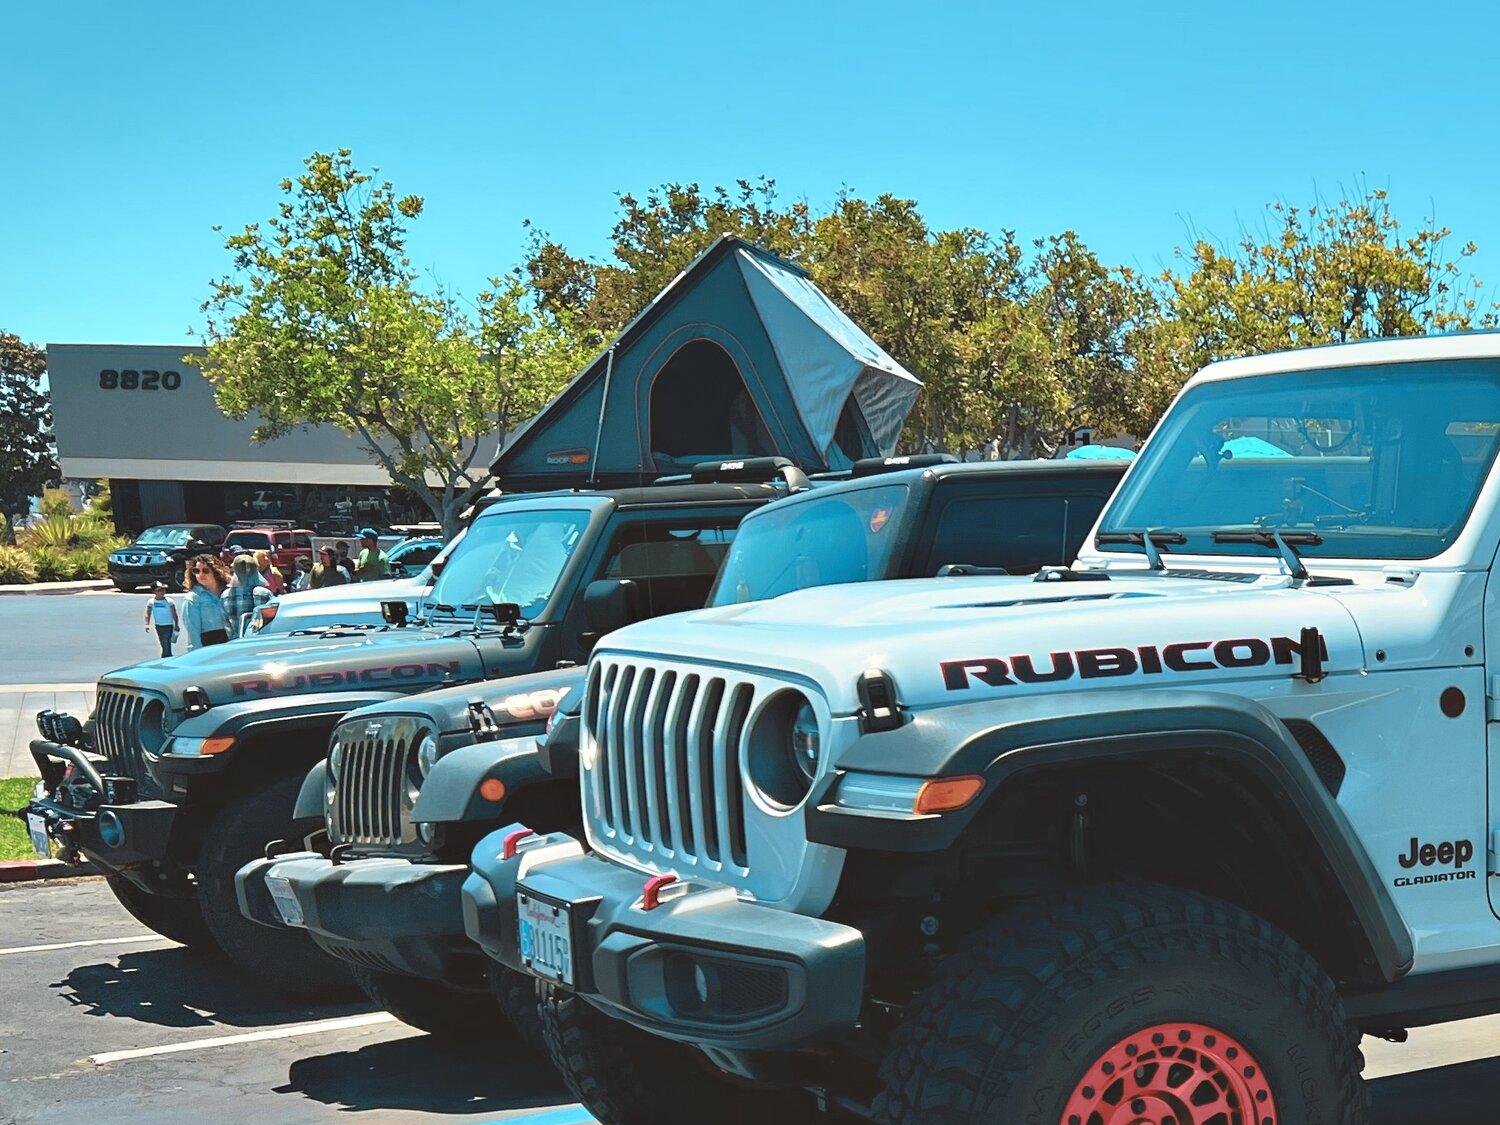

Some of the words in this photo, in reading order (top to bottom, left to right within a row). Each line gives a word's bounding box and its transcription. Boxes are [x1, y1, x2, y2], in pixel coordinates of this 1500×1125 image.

[99, 369, 182, 391] 8820
[230, 660, 460, 697] RUBICON
[939, 634, 1329, 692] RUBICON
[1398, 837, 1473, 869] Jeep
[1393, 870, 1476, 888] GLADIATOR
